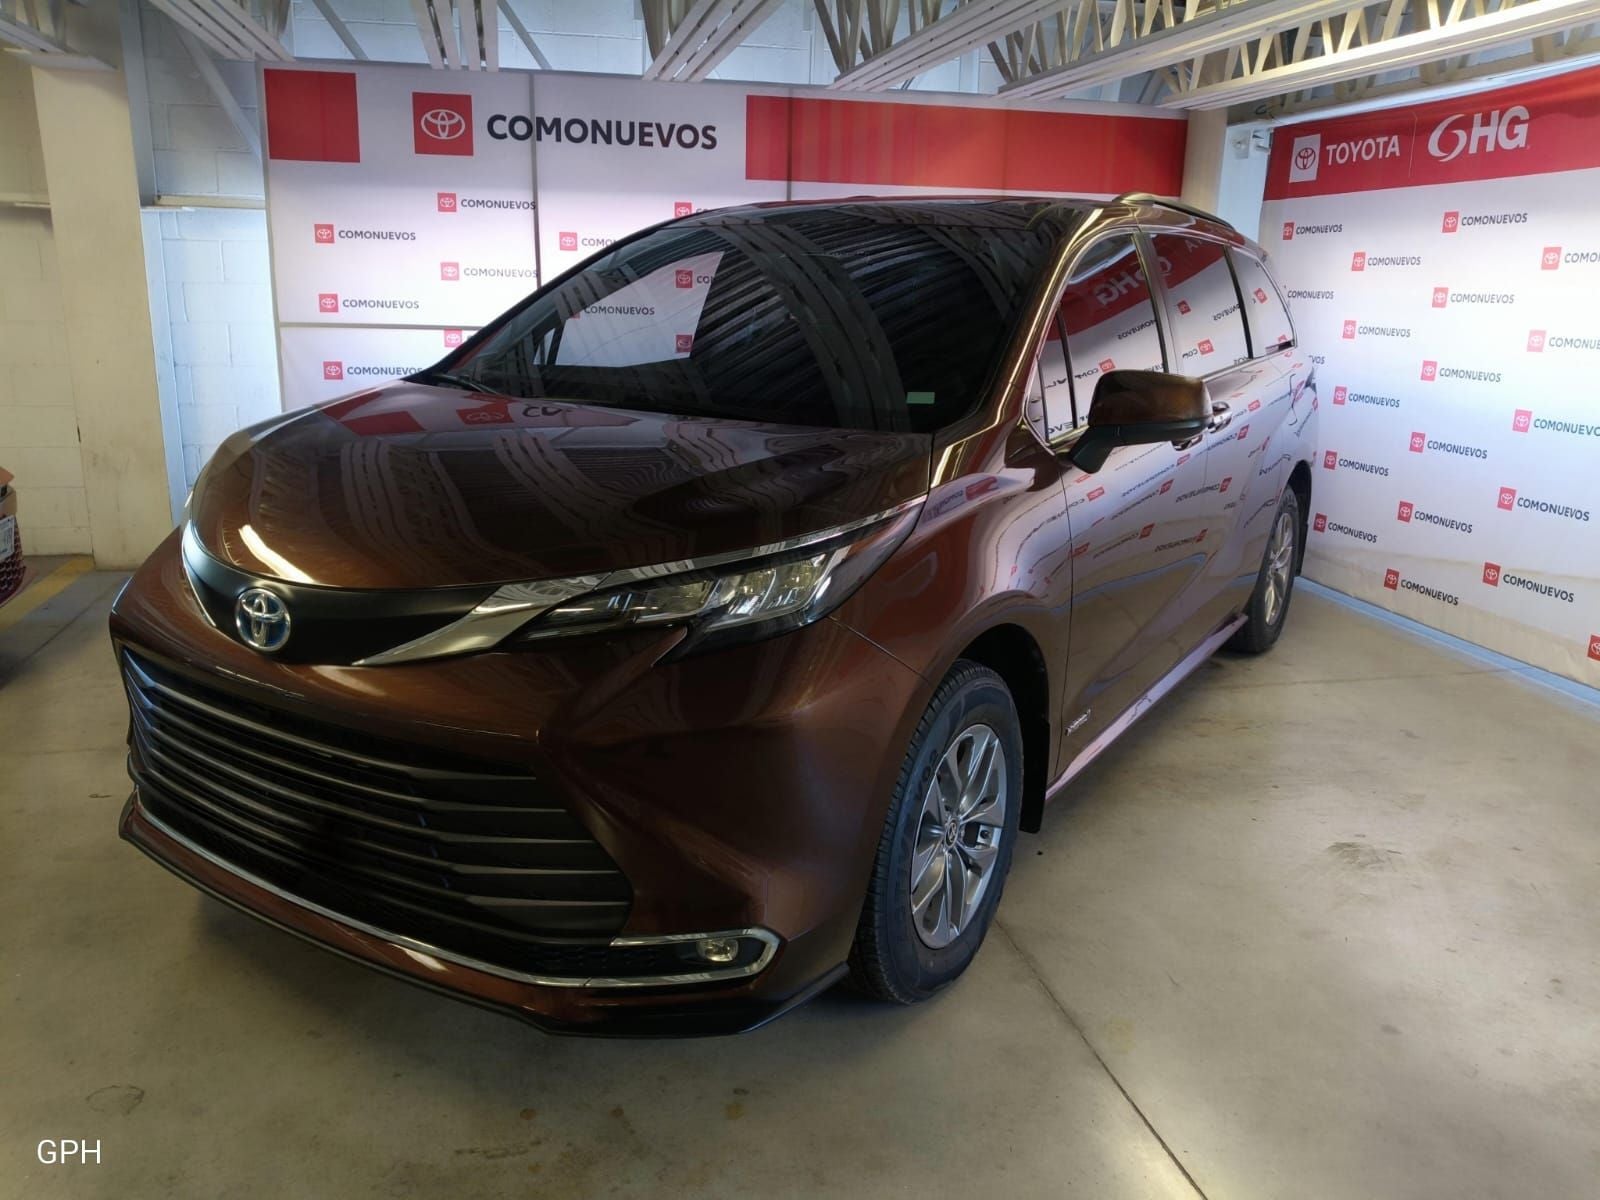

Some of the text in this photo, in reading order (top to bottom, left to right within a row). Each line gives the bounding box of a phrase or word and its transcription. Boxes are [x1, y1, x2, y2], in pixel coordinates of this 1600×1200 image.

[487, 114, 718, 150] COMONUEVOS
[1326, 135, 1401, 166] TOYOTA
[460, 199, 536, 210] COMONUEVOS
[1461, 212, 1528, 226] COMONUEVOS
[338, 230, 416, 241] COMONUEVOS
[1295, 224, 1343, 235] COMONUEVOS
[1367, 256, 1422, 267] COMONUEVOS
[463, 267, 538, 278] COMONUEVOS
[1287, 290, 1334, 300] COMONUEVOS
[1450, 293, 1515, 305] COMONUEVOS
[342, 299, 419, 310] COMONUEVOS
[584, 305, 655, 316] COMONUEVOS
[1358, 326, 1411, 338] COMONUEVOS
[1439, 367, 1501, 383] COMONUEVOS
[1348, 392, 1400, 408] COMONUEVOS
[1427, 439, 1488, 460] COMONUEVOS
[1338, 458, 1389, 477] COMONUEVOS
[1517, 497, 1590, 522] COMONUEVOS
[1414, 510, 1473, 534] COMONUEVOS
[1328, 521, 1377, 544] COMONUEVOS
[1400, 578, 1459, 606] COMONUEVOS
[1503, 573, 1575, 603] COMONUEVOS
